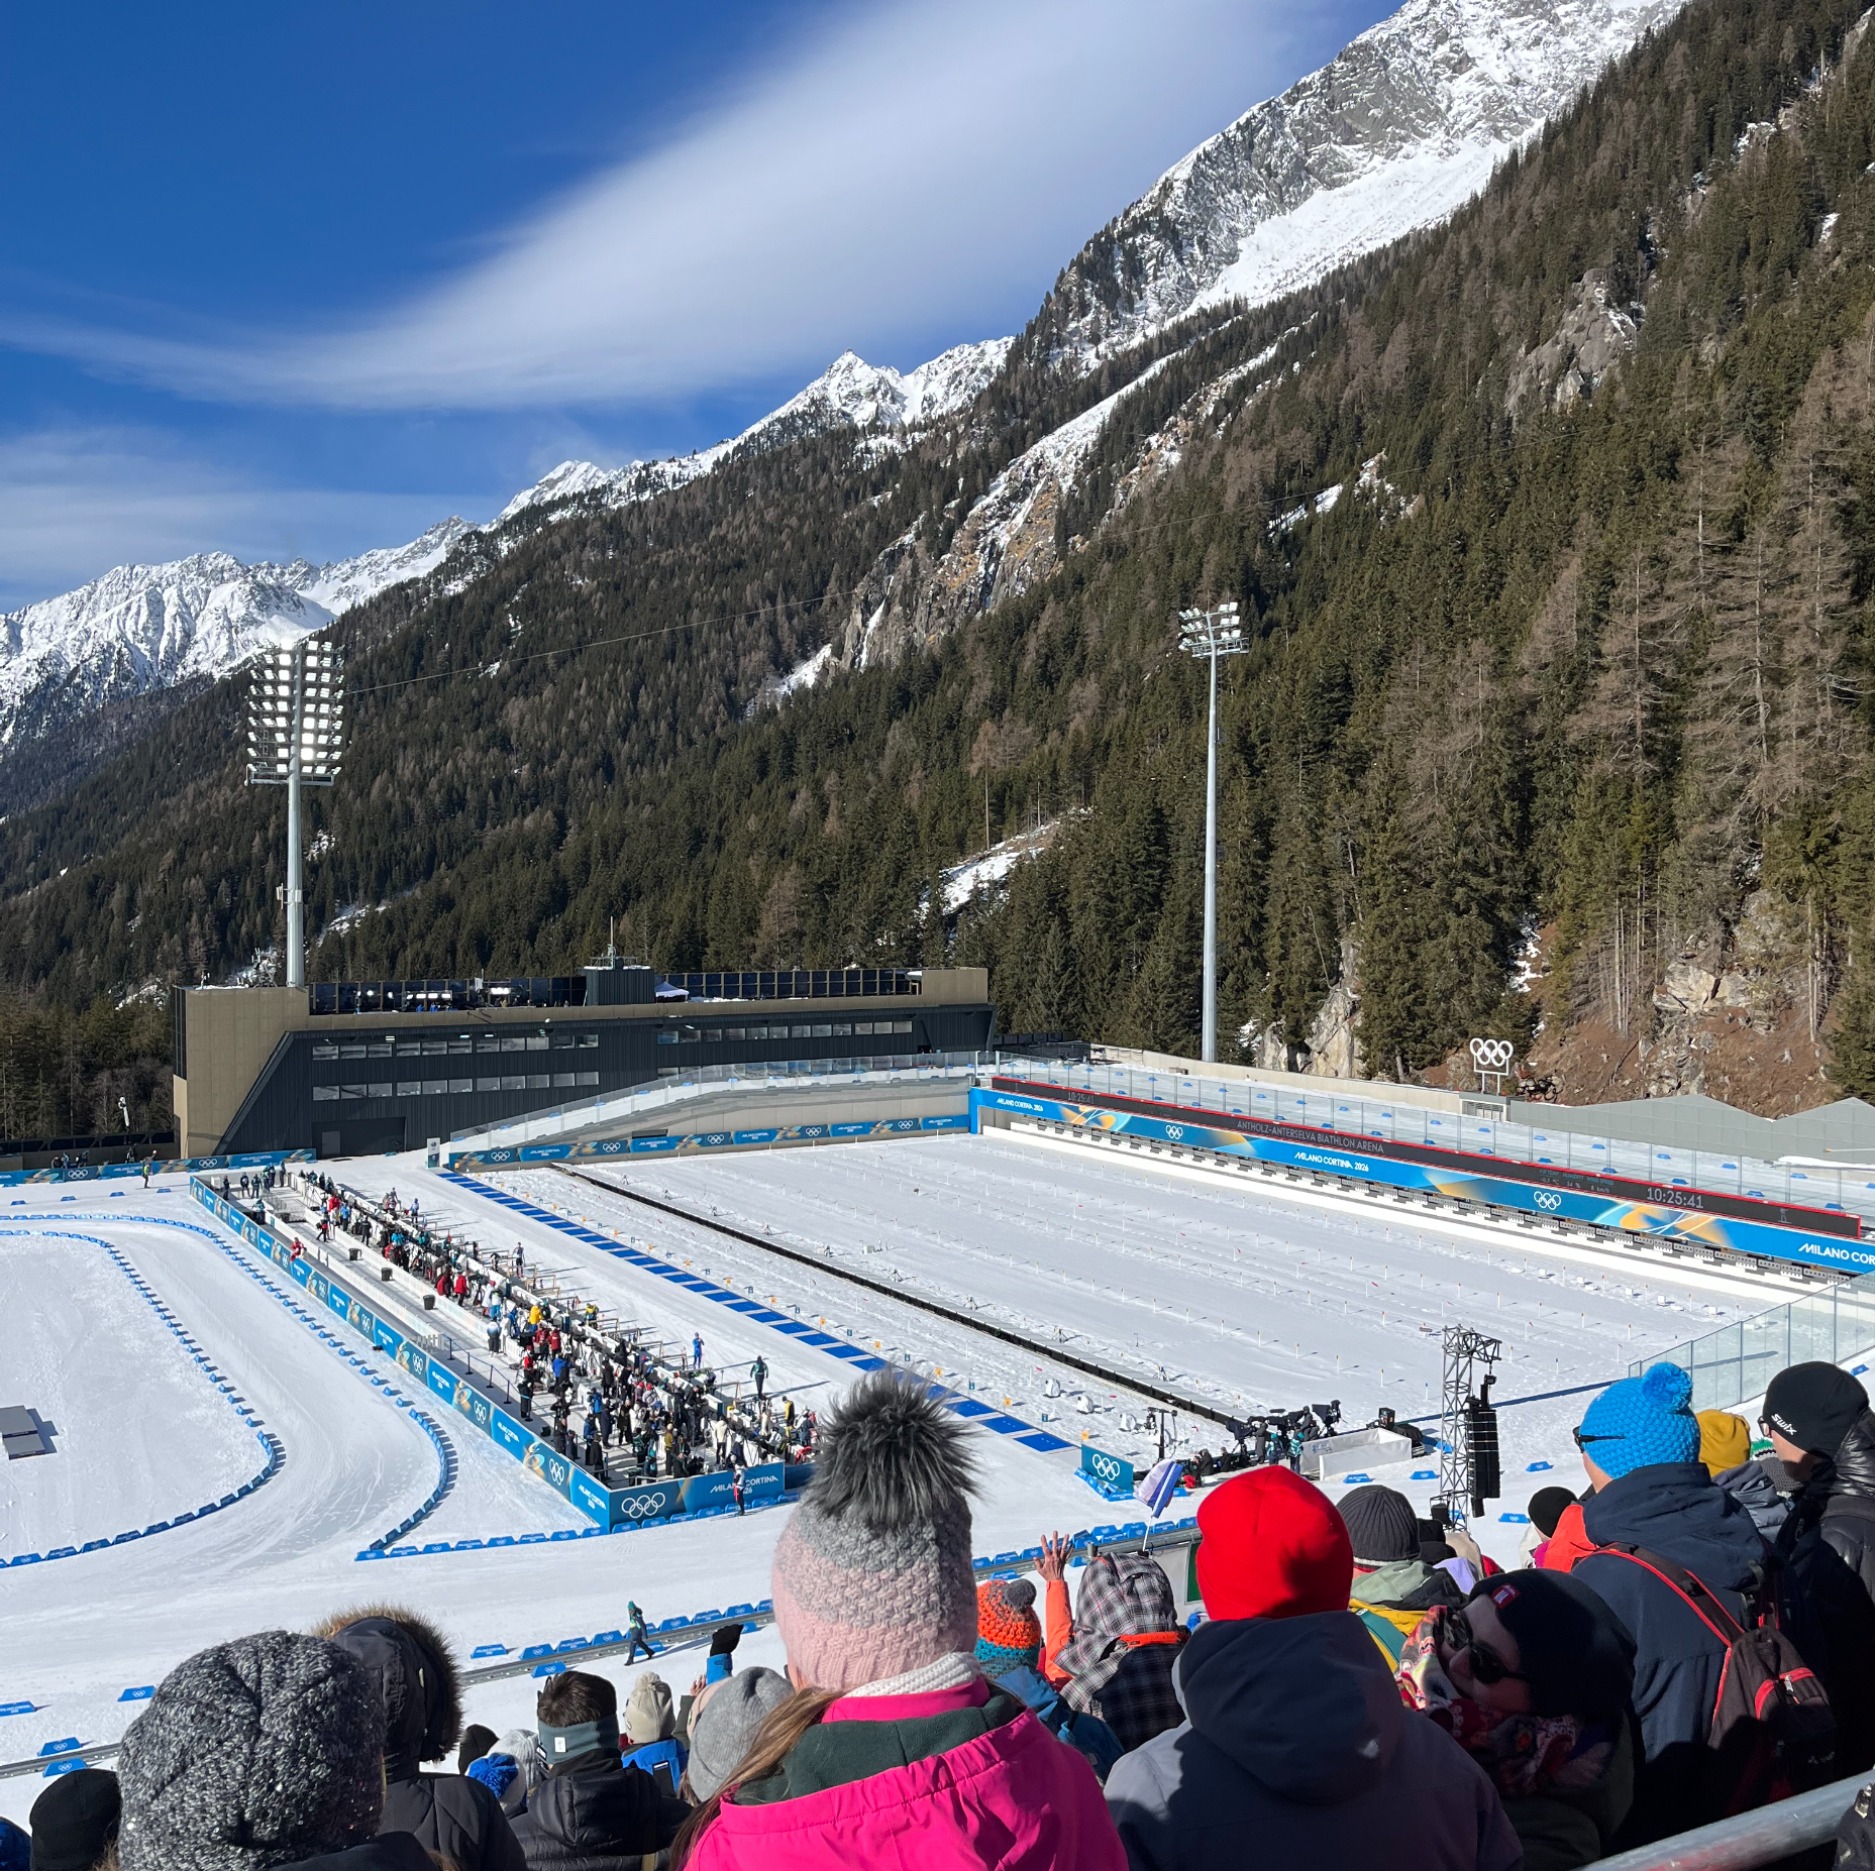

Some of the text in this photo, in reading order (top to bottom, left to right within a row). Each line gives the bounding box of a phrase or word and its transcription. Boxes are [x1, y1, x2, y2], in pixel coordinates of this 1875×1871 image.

[996, 1098, 1014, 1107] MILANO
[1015, 1100, 1033, 1109] CORTINA
[1237, 1120, 1384, 1153] ANTHOLZ-ANTERSELVA BIATHLON ARENA
[1294, 1151, 1369, 1172] MILANO CORTINA 2026
[1646, 1187, 1704, 1208] 10:25:41
[1798, 1242, 1850, 1260] MILANO
[1771, 1413, 1797, 1436] Swix
